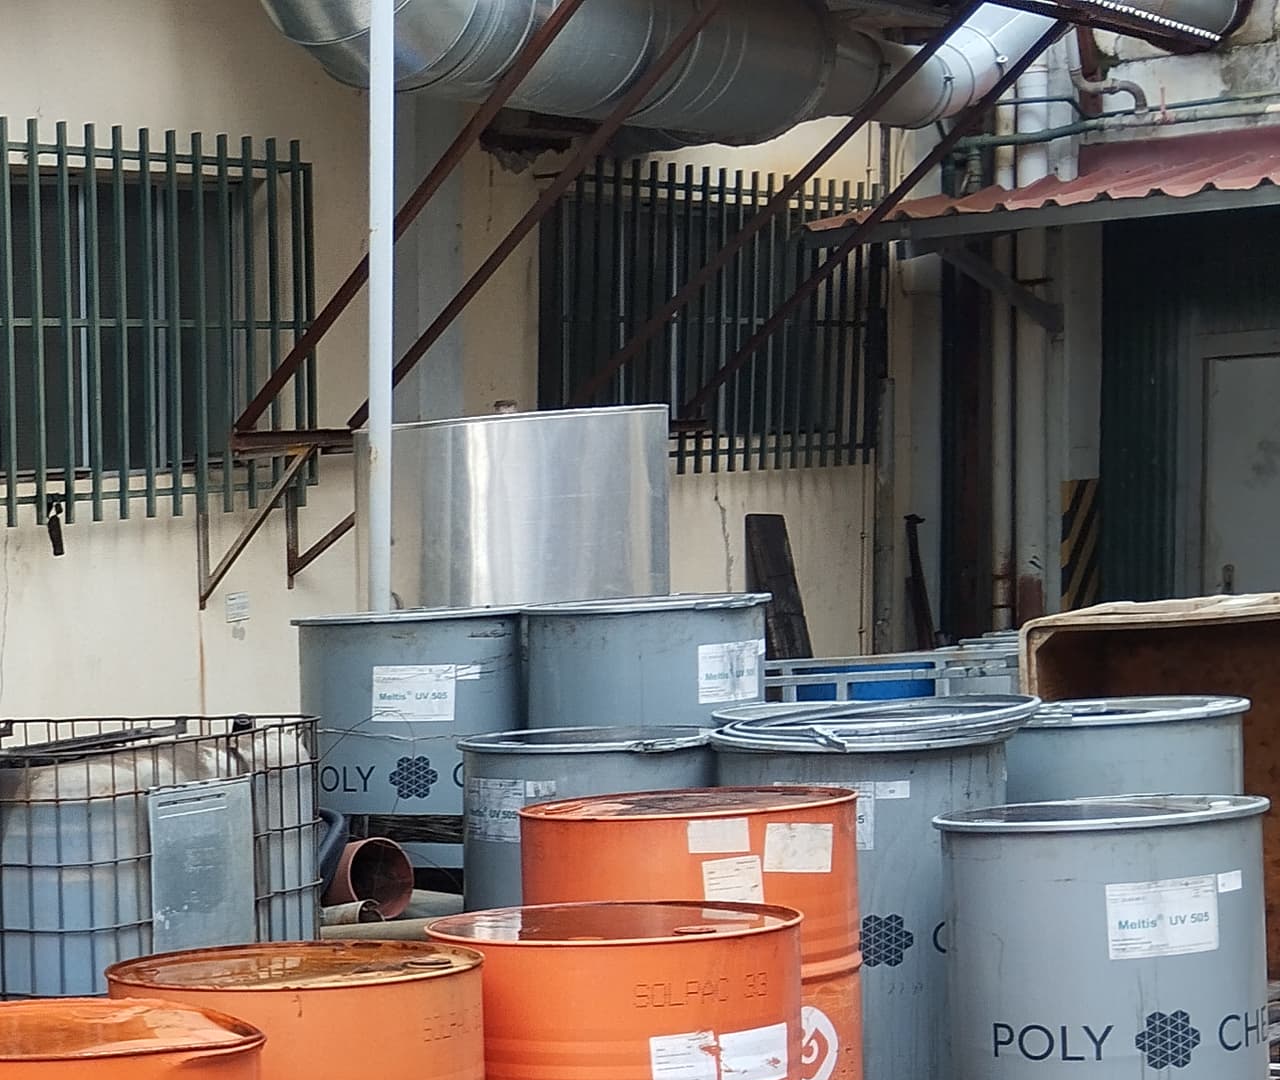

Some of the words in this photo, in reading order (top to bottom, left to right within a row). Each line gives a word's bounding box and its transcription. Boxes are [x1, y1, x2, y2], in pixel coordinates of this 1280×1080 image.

[320, 765, 376, 793] OLY
[1168, 914, 1187, 926] UV
[1191, 911, 1210, 924] 505
[992, 1022, 1114, 1062] POLY
